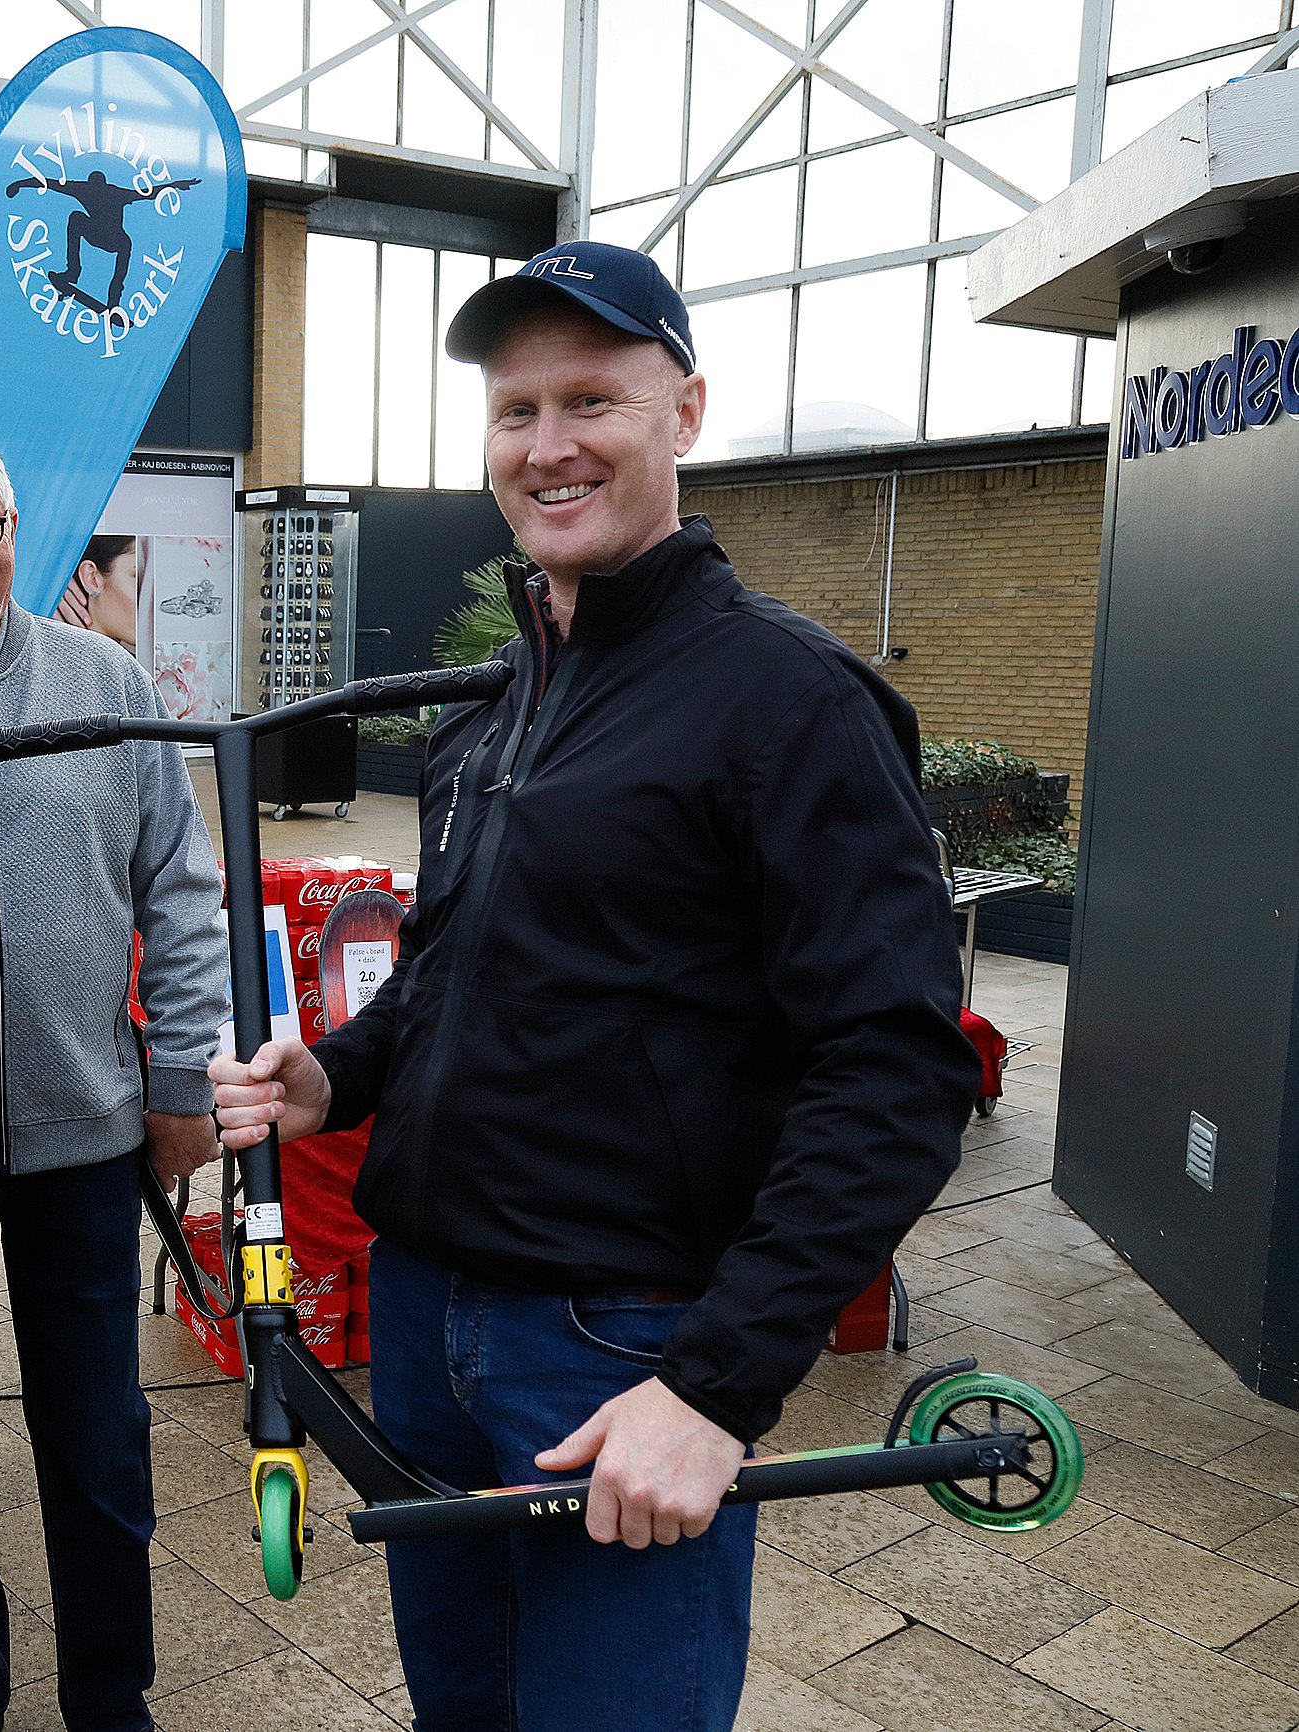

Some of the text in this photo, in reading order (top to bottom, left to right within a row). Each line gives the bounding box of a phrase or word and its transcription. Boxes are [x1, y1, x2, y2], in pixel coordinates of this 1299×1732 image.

[10, 101, 181, 216] Jyllinge
[7, 214, 184, 358] Skatepark
[142, 461, 155, 469] KAJ
[156, 461, 186, 470] BOJESEN
[191, 462, 231, 472] RABINOVICH
[439, 810, 453, 852] abacus
[451, 775, 460, 808] count
[247, 1206, 262, 1220] CE
[529, 1498, 581, 1516] NKD
